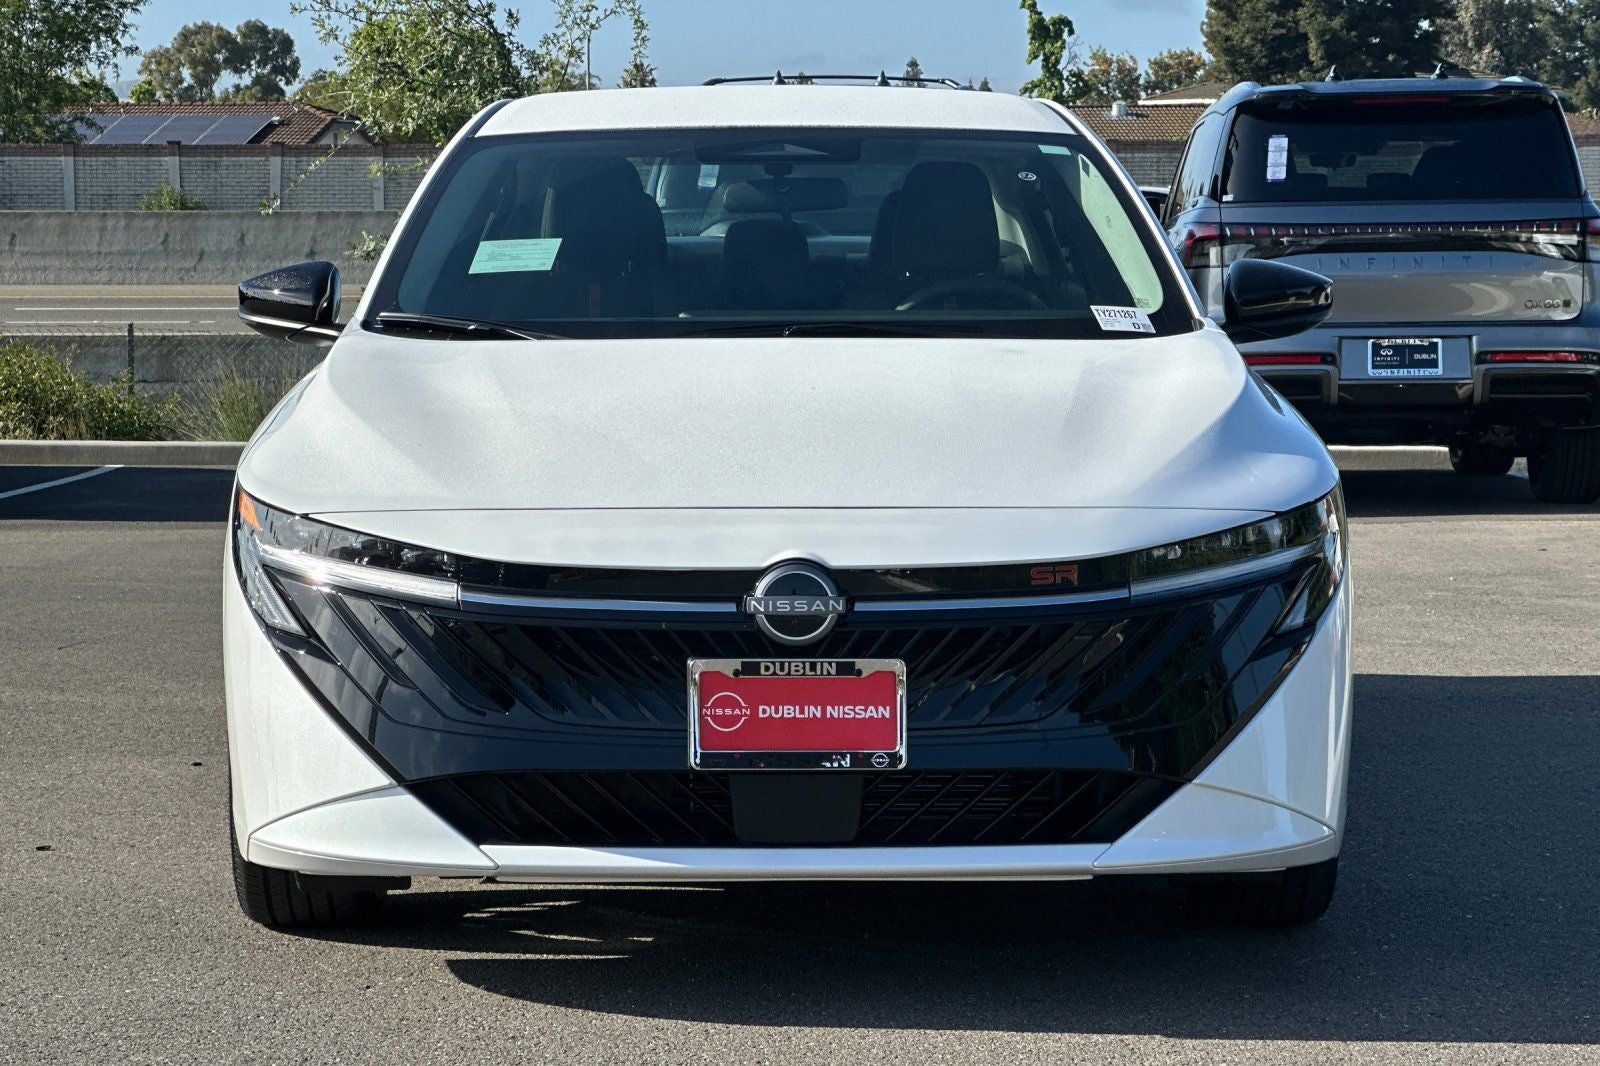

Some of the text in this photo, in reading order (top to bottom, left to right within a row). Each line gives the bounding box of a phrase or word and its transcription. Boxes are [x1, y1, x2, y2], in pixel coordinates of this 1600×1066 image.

[1316, 255, 1493, 270] INFINITI
[1030, 564, 1078, 586] SR
[750, 599, 843, 612] NISSAN
[760, 662, 837, 676] DUBLIN
[702, 708, 750, 716] NISSAN
[758, 705, 890, 719] DUBLIN NISSAN
